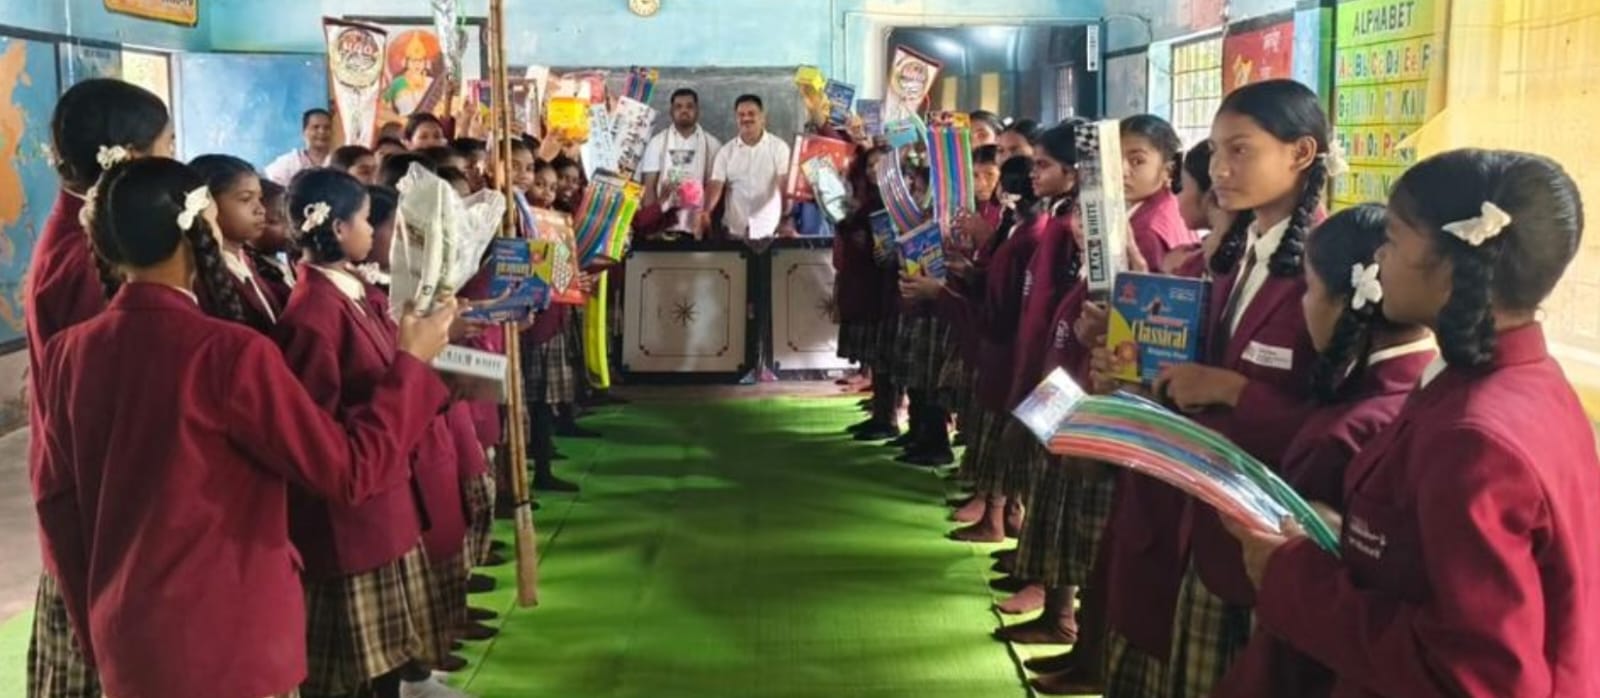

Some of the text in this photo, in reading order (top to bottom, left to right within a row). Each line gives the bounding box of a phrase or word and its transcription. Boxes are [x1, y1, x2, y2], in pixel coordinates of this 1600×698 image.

[1352, 0, 1415, 37] ALPHABET
[1086, 201, 1100, 236] WHITE
[1132, 319, 1189, 351] Classical
